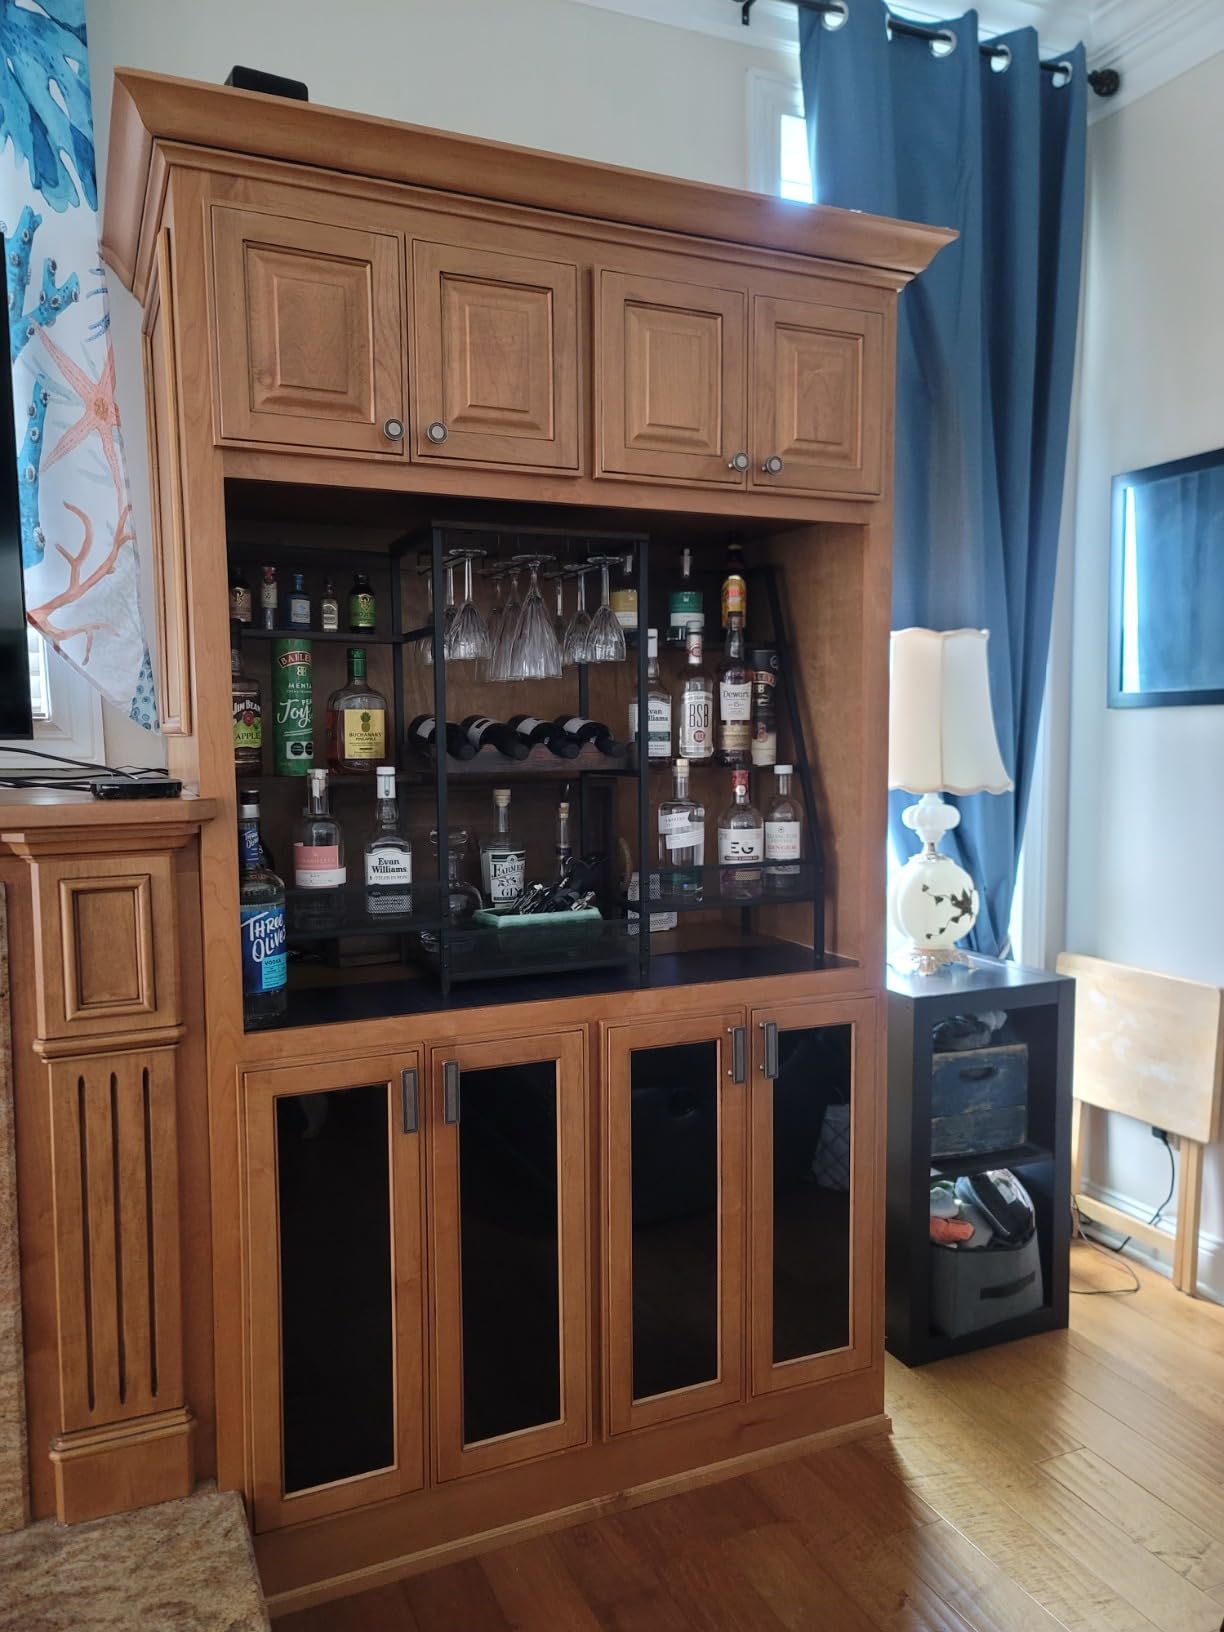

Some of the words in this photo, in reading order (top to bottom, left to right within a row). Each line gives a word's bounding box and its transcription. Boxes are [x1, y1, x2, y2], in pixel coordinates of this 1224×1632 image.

[280, 653, 312, 665] BAILE
[233, 702, 245, 714] JIM
[277, 698, 311, 728] Joy
[689, 703, 709, 728] BSB
[235, 732, 261, 740] APPLE
[378, 857, 400, 866] Evan
[371, 865, 408, 874] Williams
